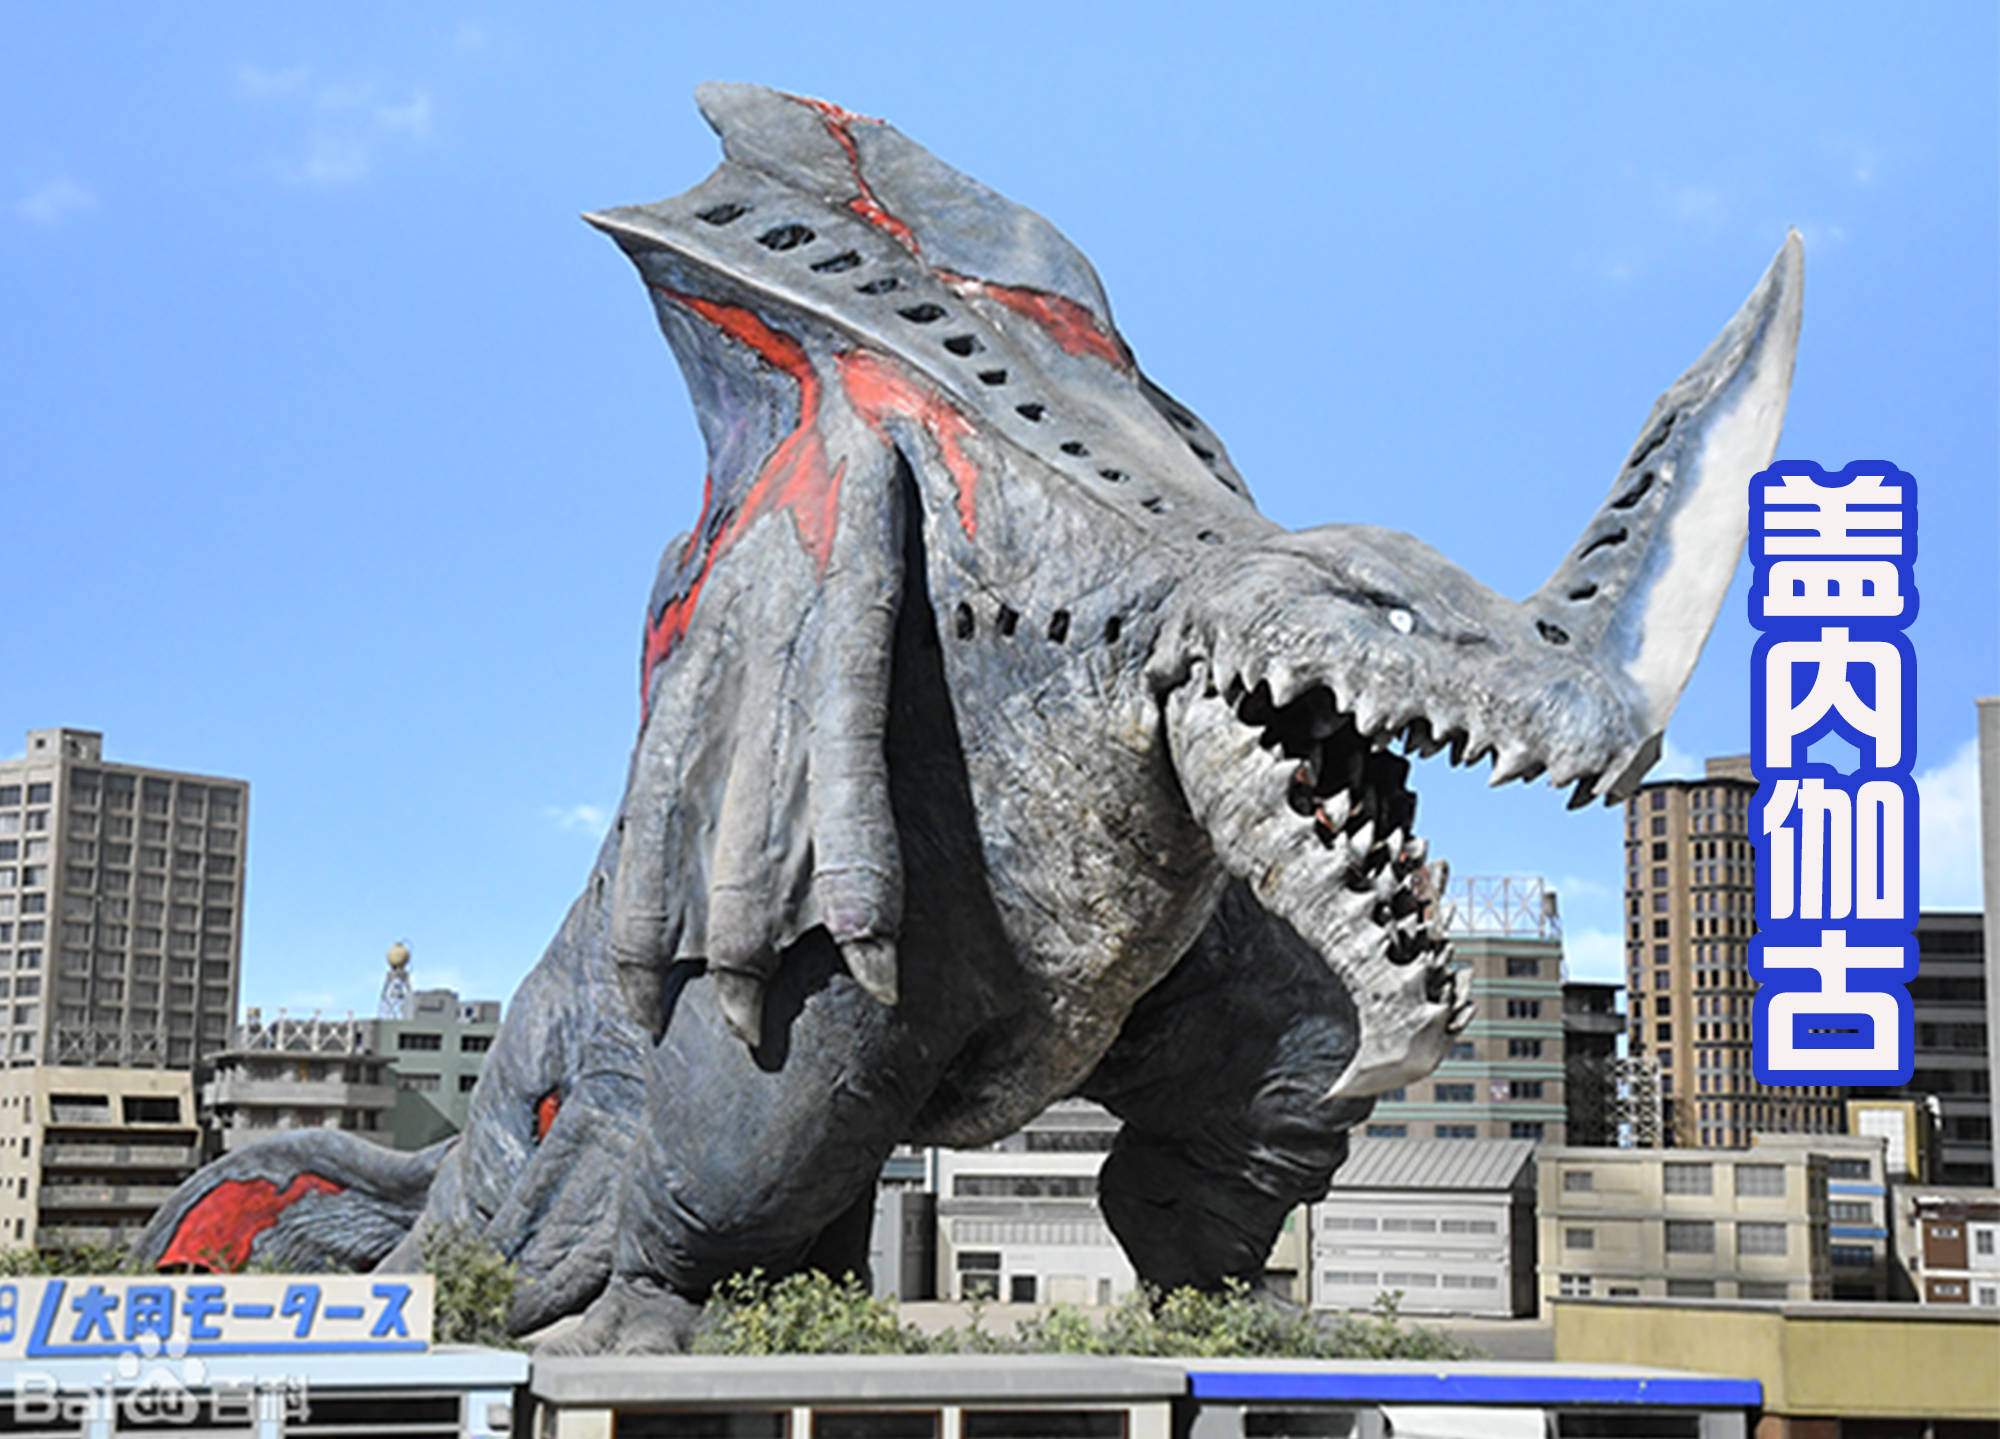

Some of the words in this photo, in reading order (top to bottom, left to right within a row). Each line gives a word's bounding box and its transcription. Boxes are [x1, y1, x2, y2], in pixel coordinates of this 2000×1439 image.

[70, 1284, 413, 1341] 大岡モータース
